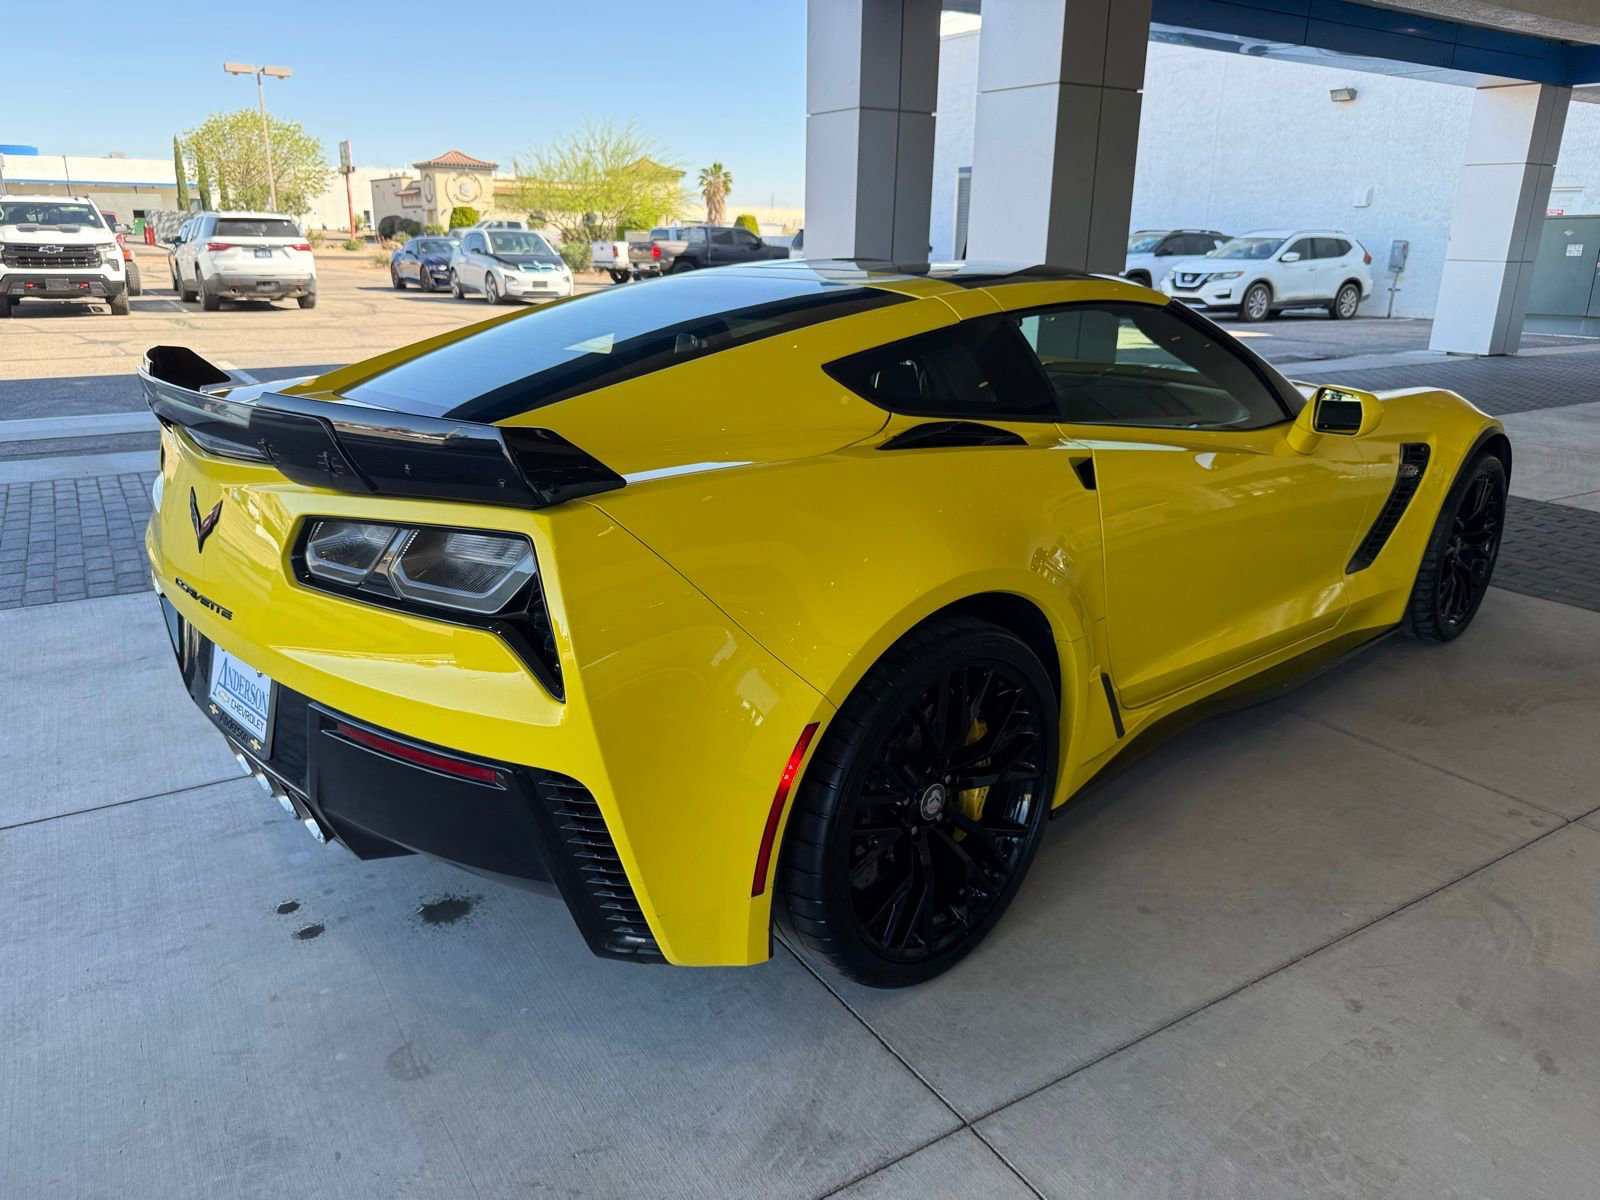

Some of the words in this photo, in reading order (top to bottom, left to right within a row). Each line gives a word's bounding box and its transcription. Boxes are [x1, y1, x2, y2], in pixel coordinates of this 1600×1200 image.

[175, 576, 233, 621] CORVETTE
[212, 657, 269, 715] ANDERSON
[230, 699, 264, 732] CHEVROLET
